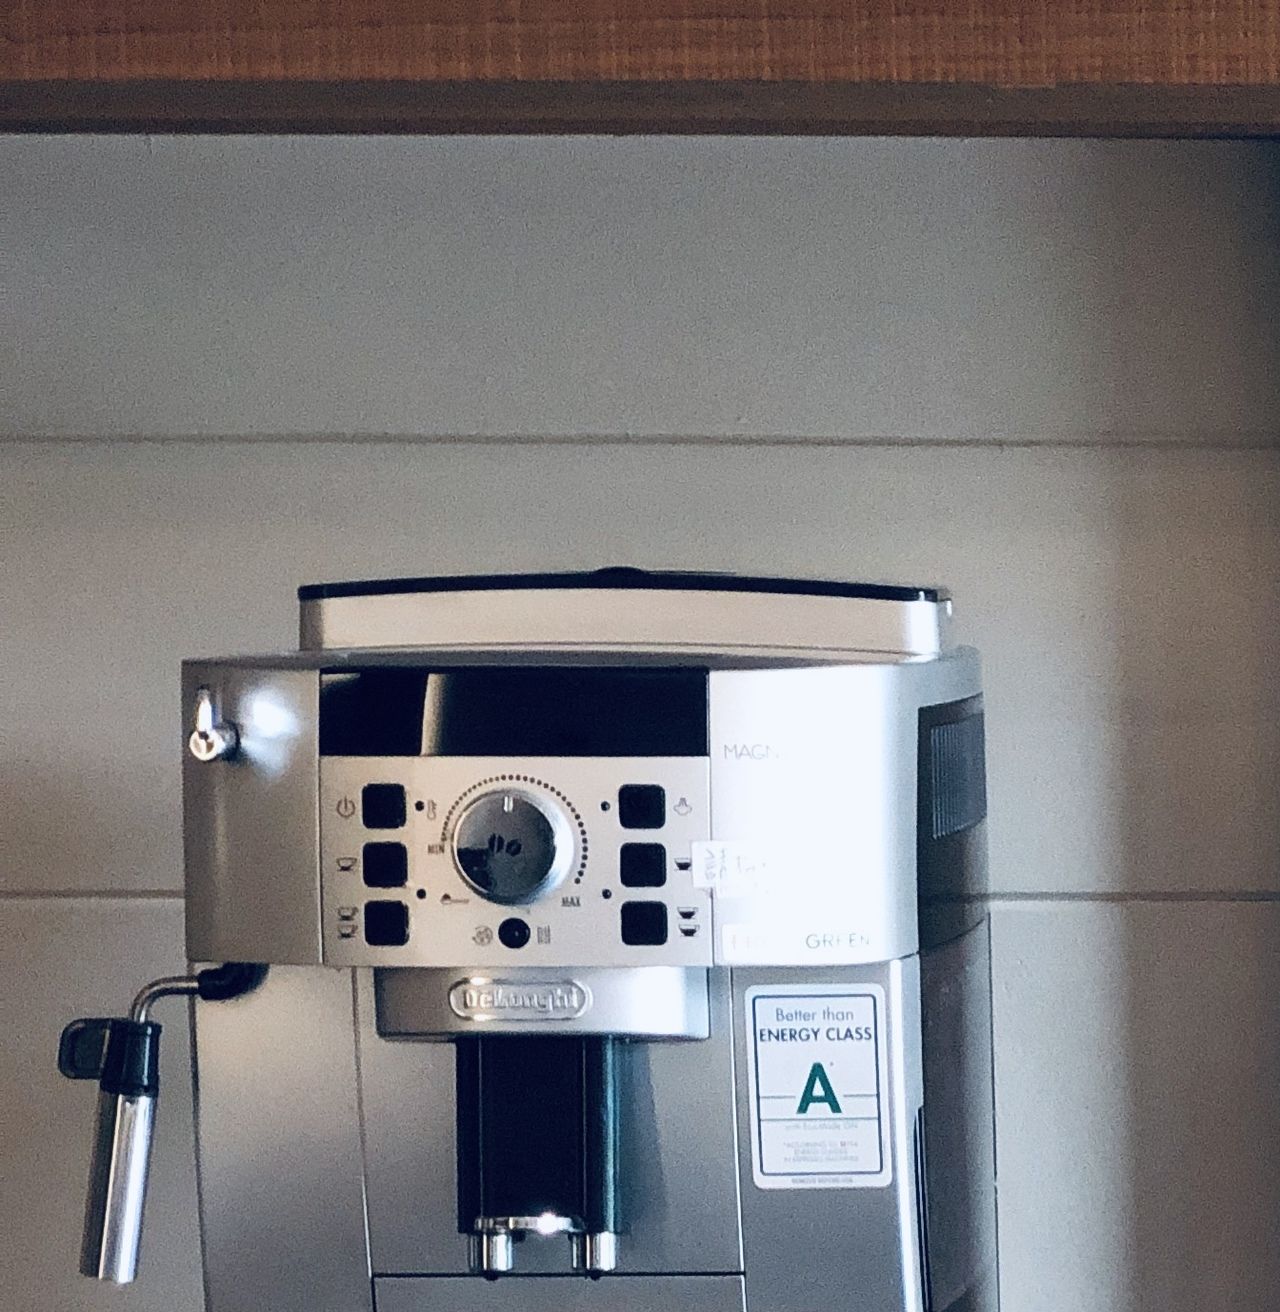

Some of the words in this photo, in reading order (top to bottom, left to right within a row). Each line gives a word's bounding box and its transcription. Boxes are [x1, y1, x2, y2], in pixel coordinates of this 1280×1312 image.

[561, 895, 582, 908] MAX
[775, 1006, 817, 1023] Better
[822, 1006, 855, 1022] than
[759, 1027, 821, 1043] ENERGY
[825, 1026, 873, 1042] CLASS
